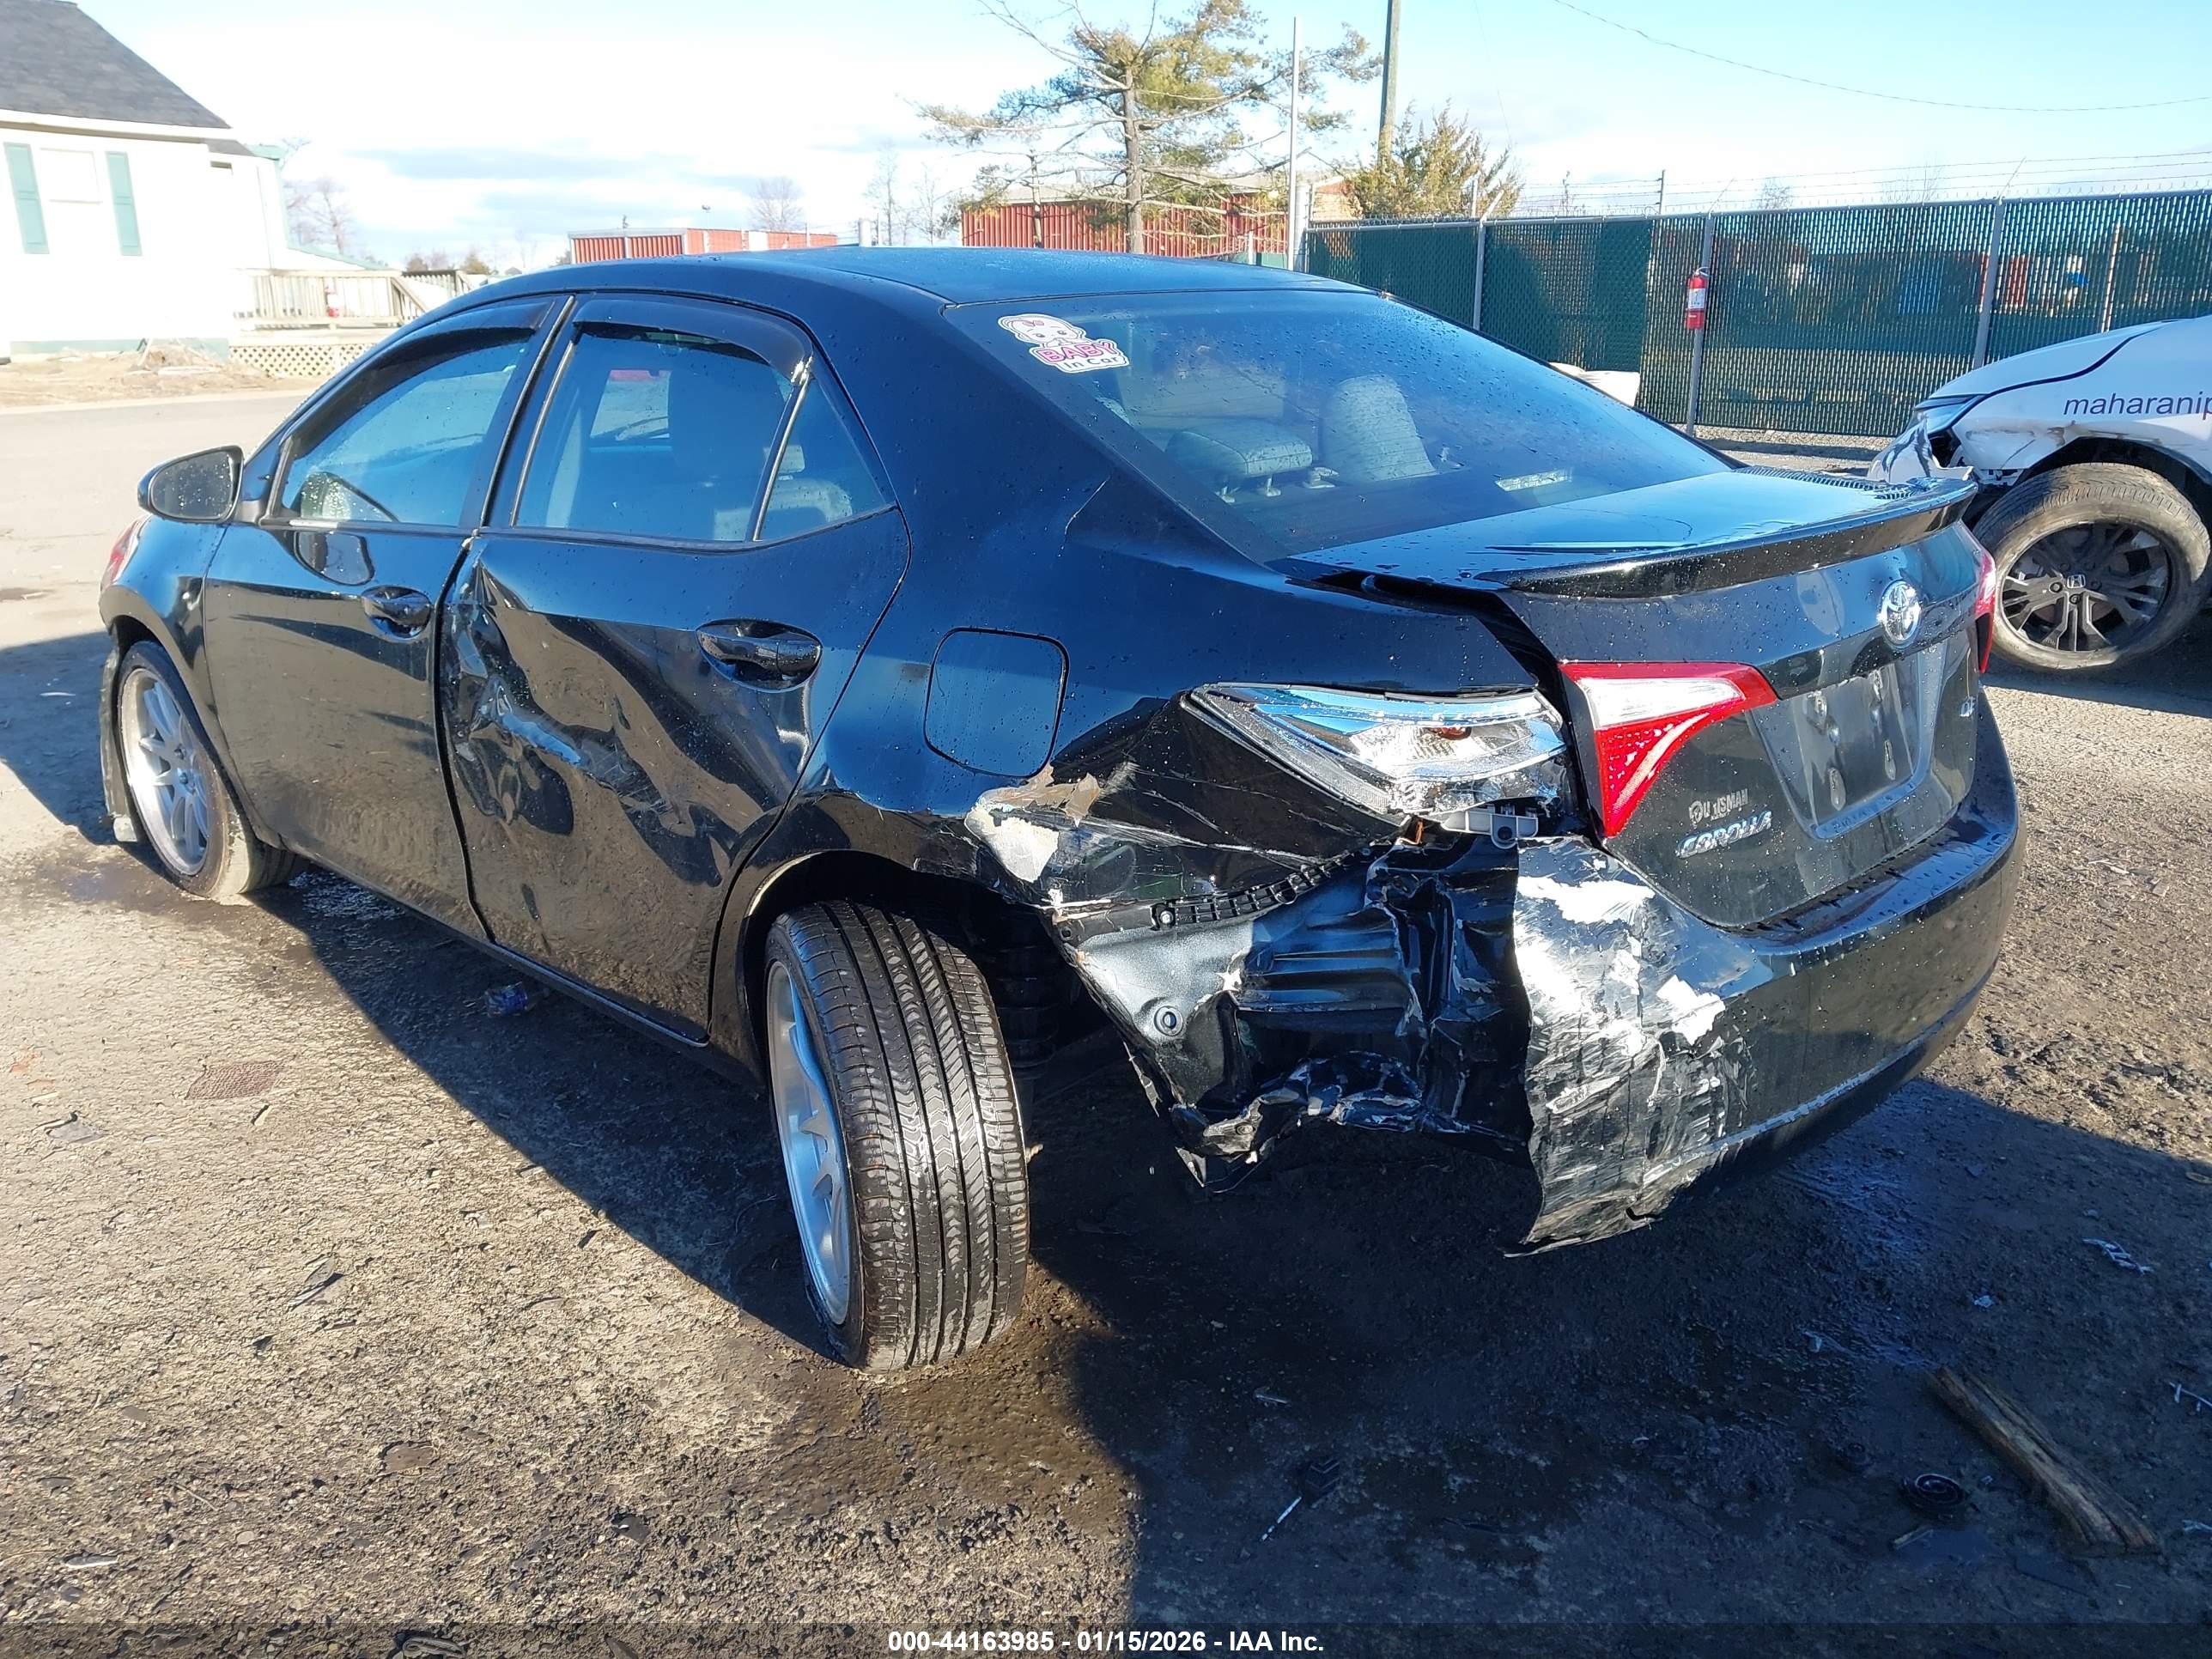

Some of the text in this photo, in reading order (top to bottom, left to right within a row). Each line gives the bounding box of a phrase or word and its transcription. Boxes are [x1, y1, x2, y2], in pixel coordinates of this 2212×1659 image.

[1037, 342, 1117, 363] BABY
[1086, 356, 1118, 365] Car
[1675, 810, 1772, 859] COROLLA
